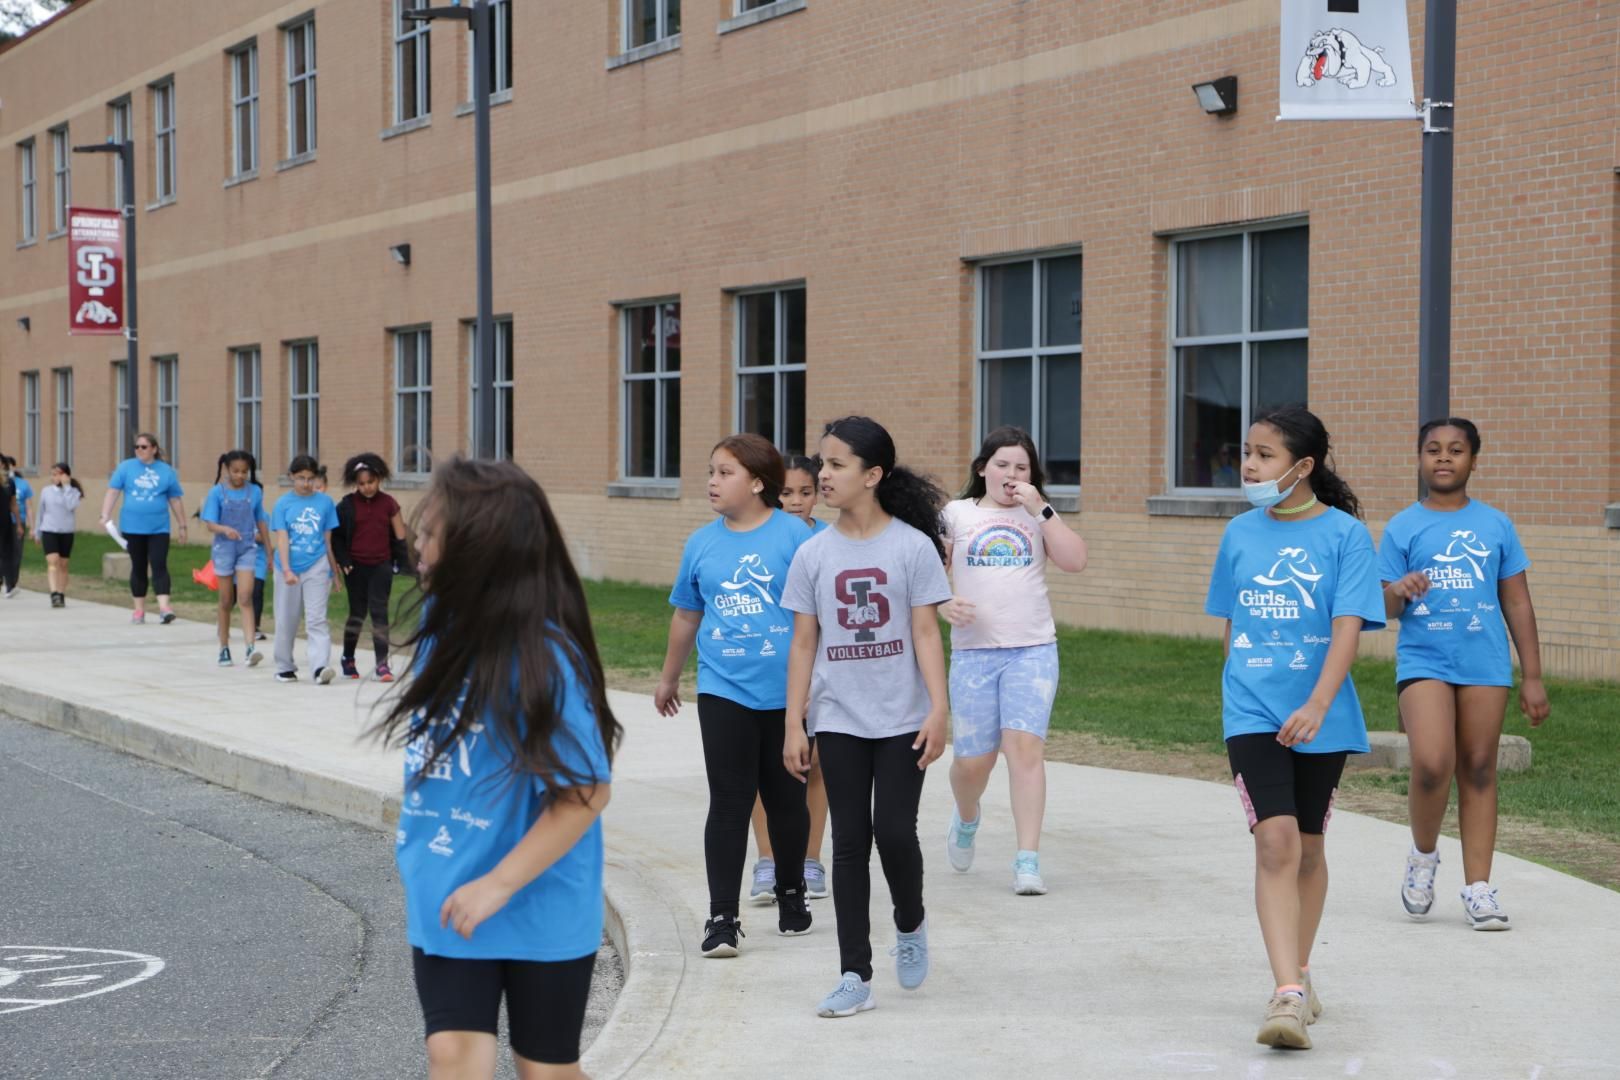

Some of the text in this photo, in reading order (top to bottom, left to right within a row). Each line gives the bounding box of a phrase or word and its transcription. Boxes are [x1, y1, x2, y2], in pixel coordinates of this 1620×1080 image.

[966, 556, 1033, 567] RAINBOW
[1442, 579, 1474, 590] run
[714, 592, 760, 609] Girls on
[1240, 589, 1285, 607] Girls
[723, 603, 763, 616] the run
[1260, 606, 1300, 619] run
[828, 641, 903, 660] VOLLEYBALL
